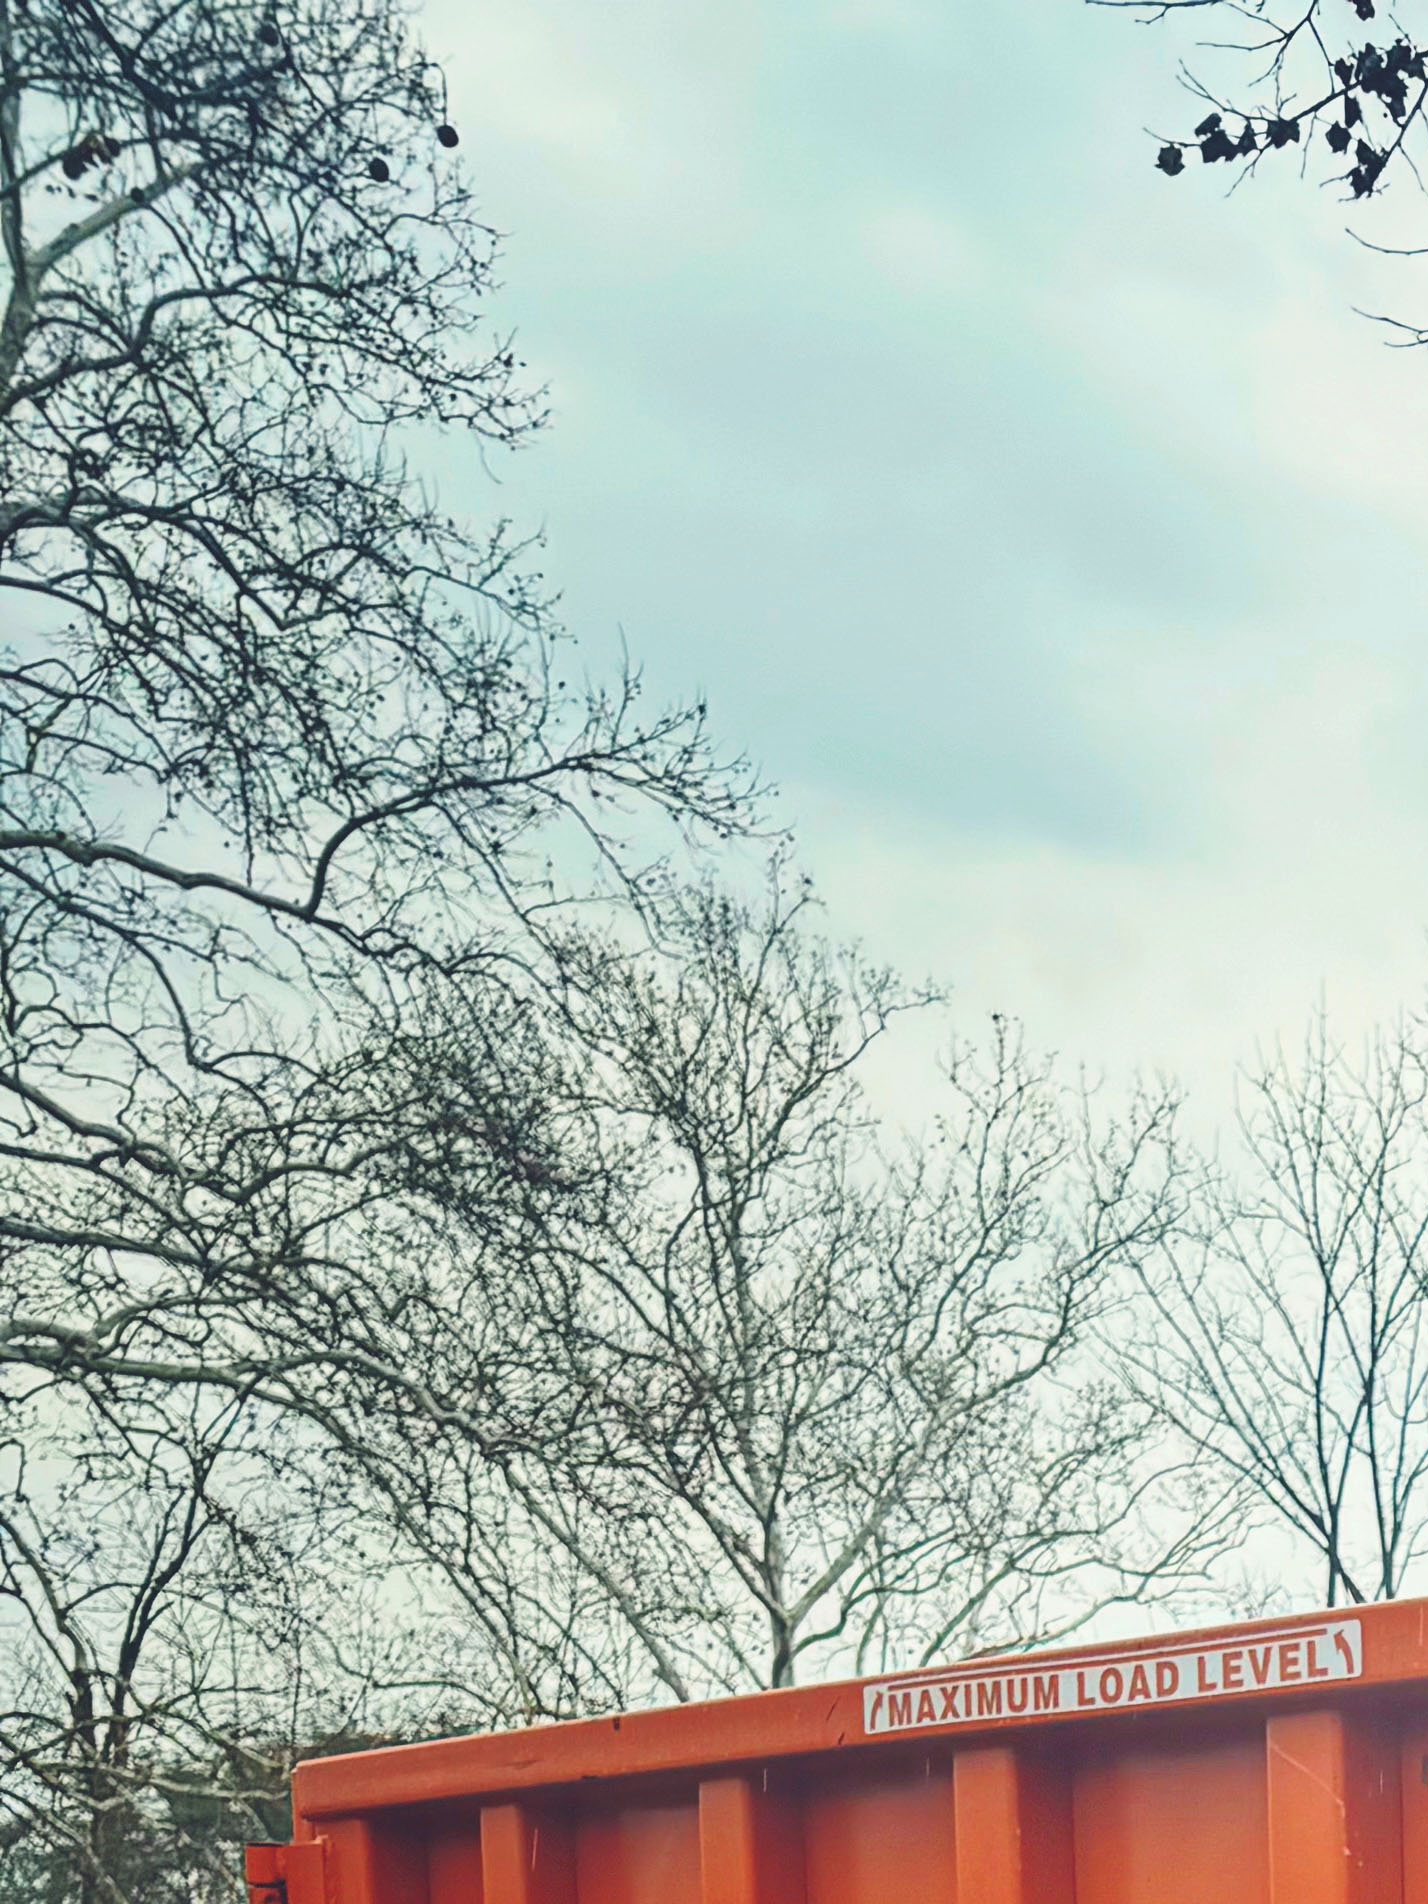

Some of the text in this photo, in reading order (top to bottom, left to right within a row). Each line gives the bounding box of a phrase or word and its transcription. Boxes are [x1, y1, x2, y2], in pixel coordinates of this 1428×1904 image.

[887, 1640, 1331, 1728] MAXIMUM LOAD LEVEL
